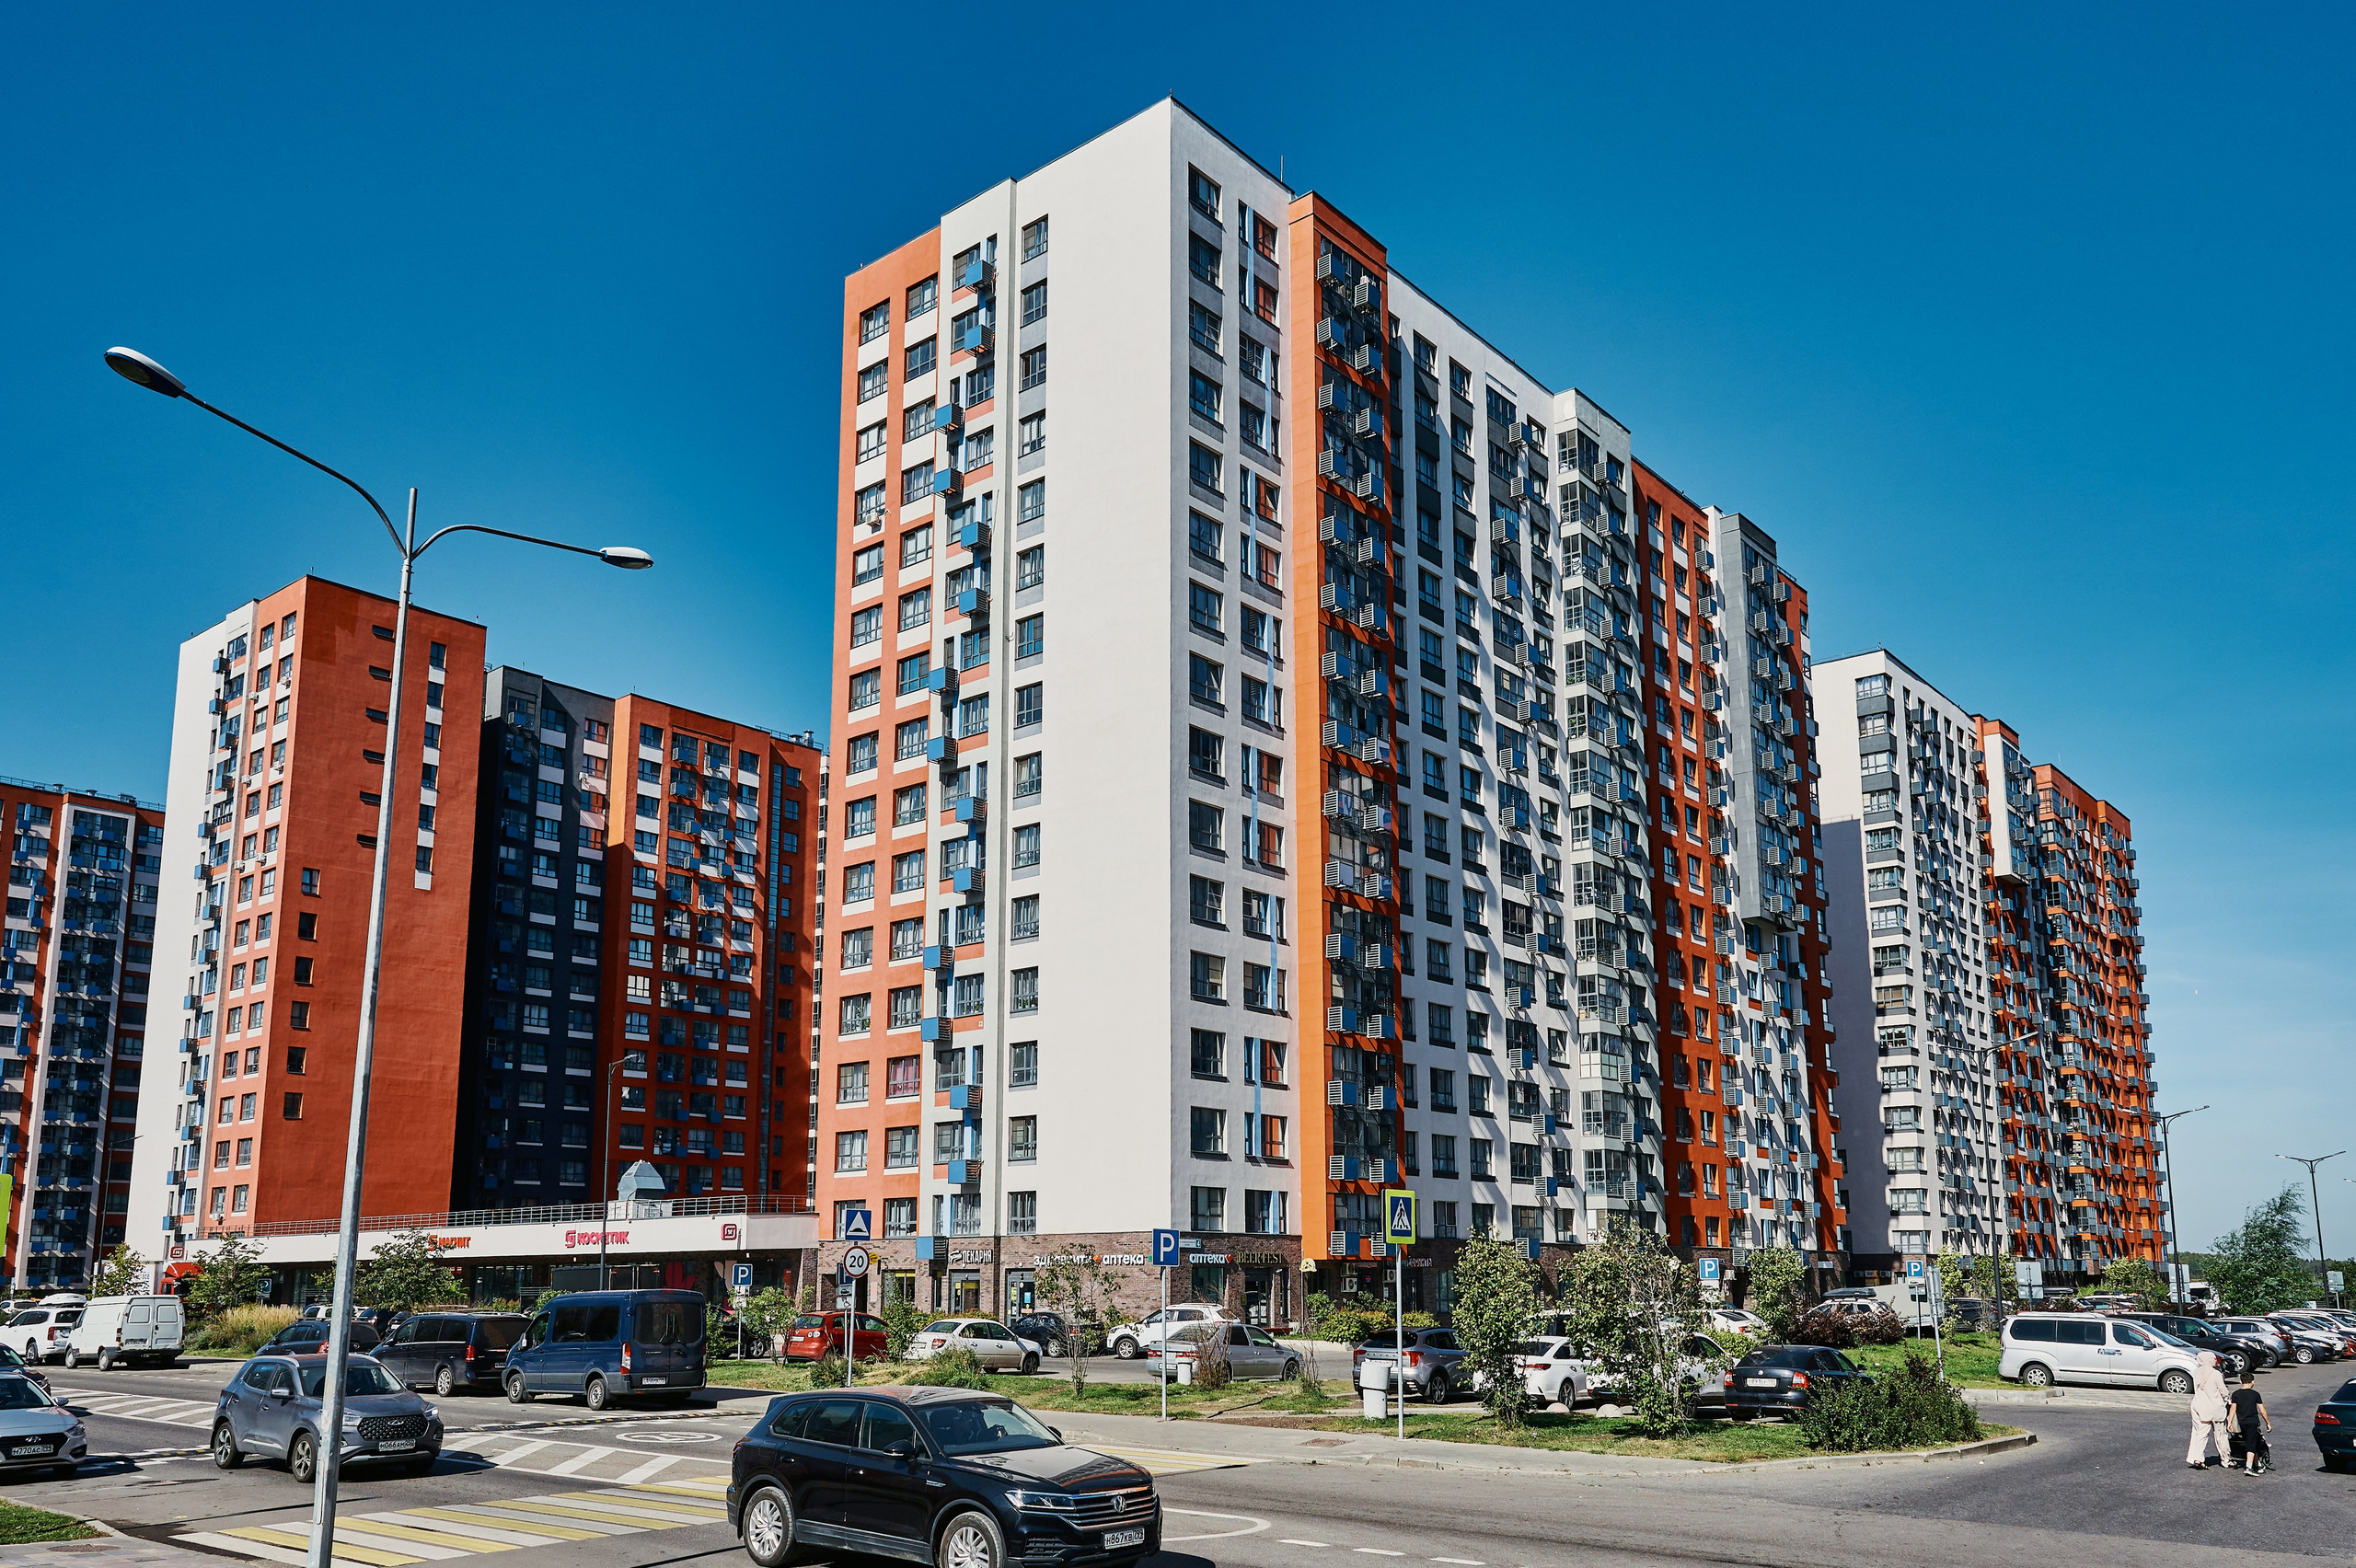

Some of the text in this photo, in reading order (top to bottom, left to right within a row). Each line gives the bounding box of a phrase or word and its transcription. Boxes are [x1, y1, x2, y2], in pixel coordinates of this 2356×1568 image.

[1160, 1233, 1175, 1262] P
[849, 1255, 864, 1268] 20
[963, 1250, 993, 1263] ПЕКАРНЯ
[1103, 1254, 1145, 1265] аптека
[1189, 1253, 1226, 1264] аптека
[738, 1267, 749, 1284] P
[1704, 1261, 1715, 1277] P
[1911, 1262, 1921, 1276] P
